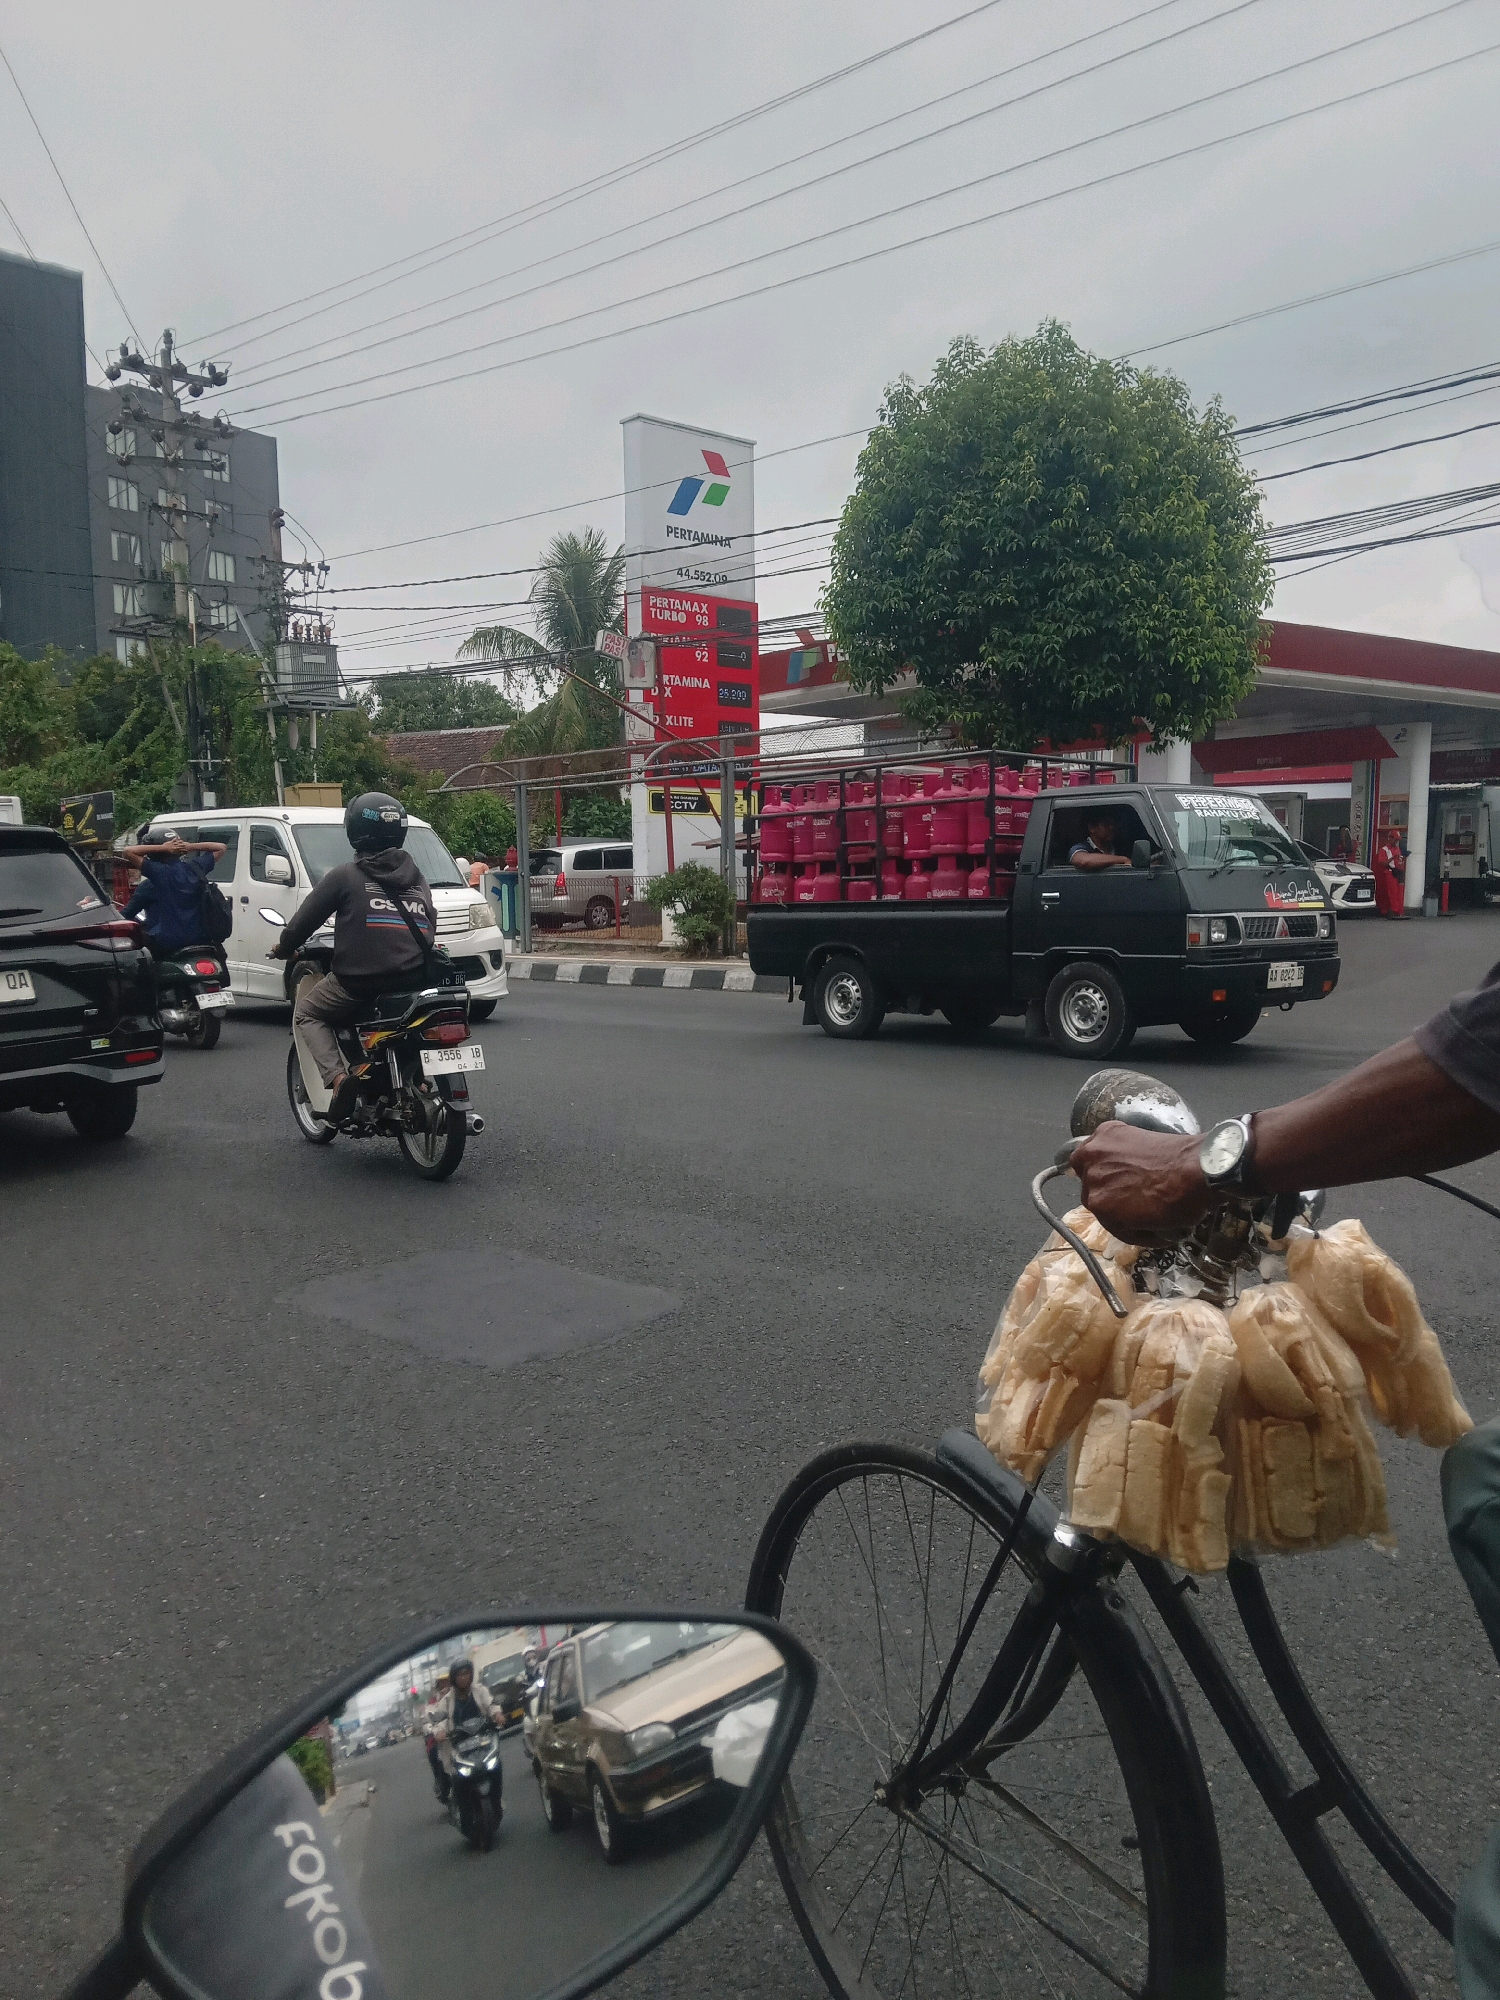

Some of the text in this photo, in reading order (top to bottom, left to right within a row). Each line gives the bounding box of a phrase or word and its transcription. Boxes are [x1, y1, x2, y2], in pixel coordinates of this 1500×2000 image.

[666, 525, 731, 548] PERTAMINA
[650, 596, 708, 614] PERTAMAX
[650, 608, 709, 626] TURBO 98
[695, 650, 709, 662] 92
[656, 674, 710, 689] RTAMINA
[651, 686, 673, 698] DX
[653, 714, 694, 727] DXLITE
[6, 972, 30, 989] QA
[423, 1052, 430, 1063] B
[438, 1049, 462, 1061] 3556
